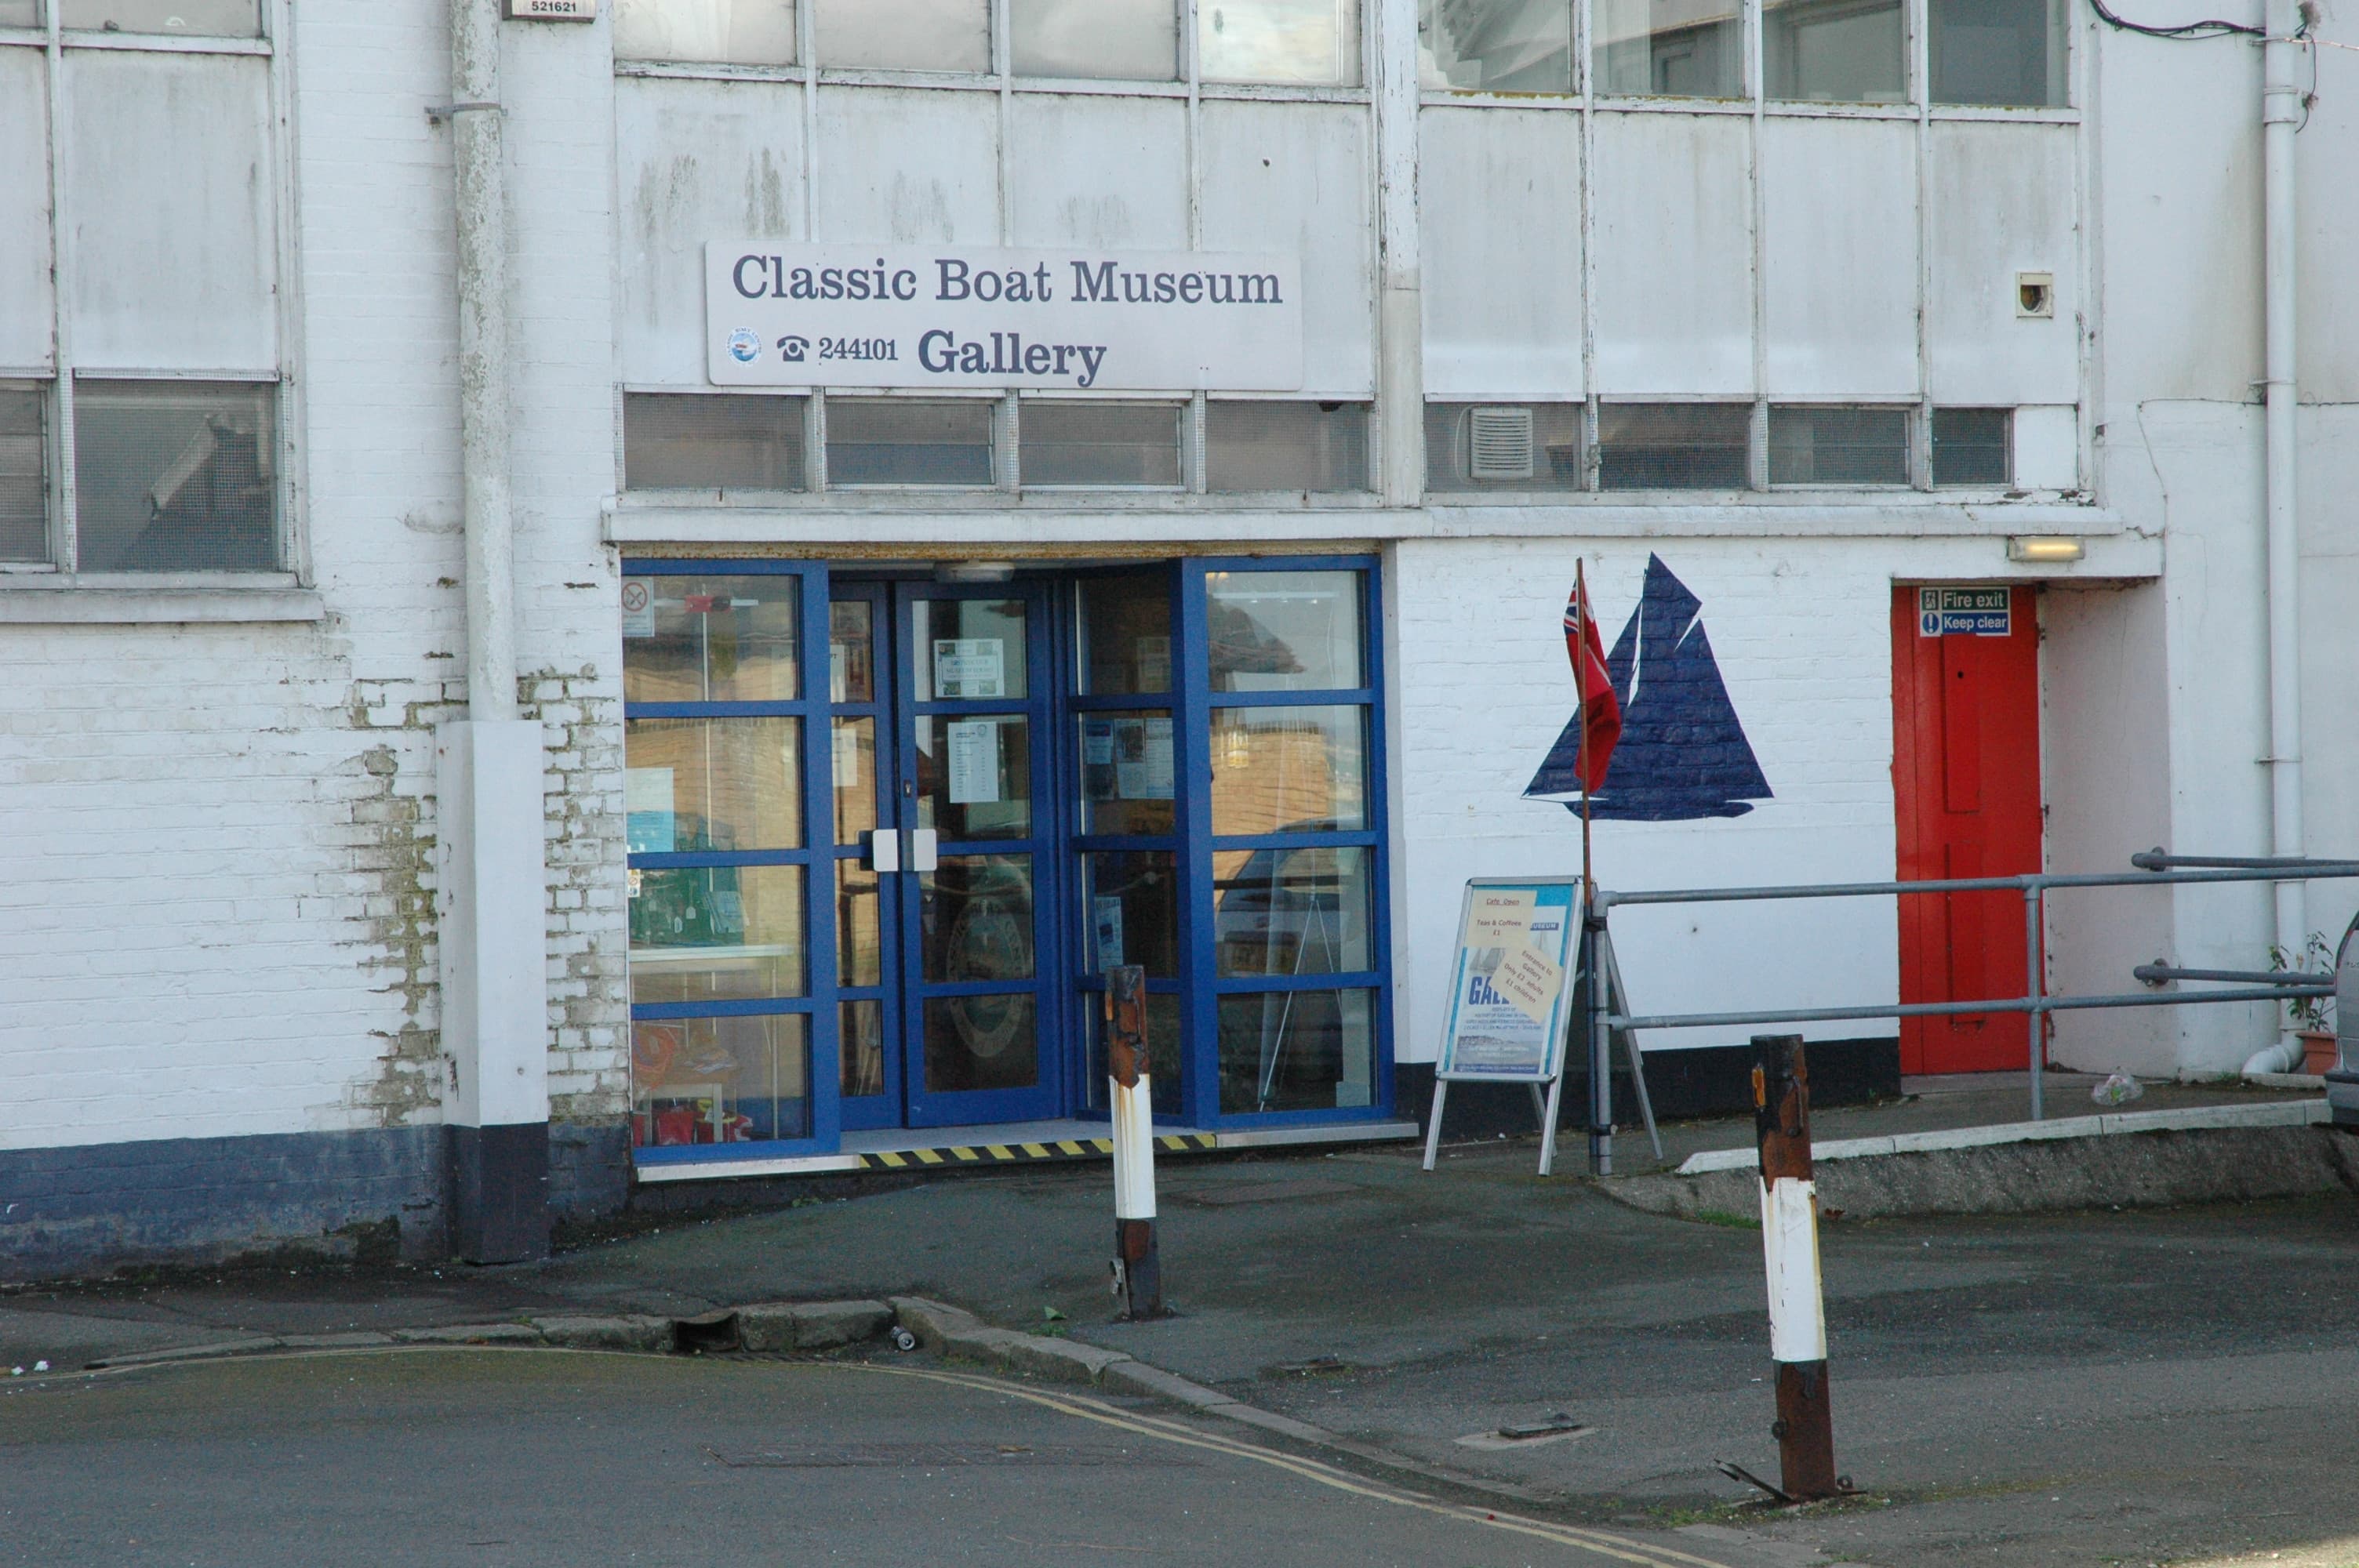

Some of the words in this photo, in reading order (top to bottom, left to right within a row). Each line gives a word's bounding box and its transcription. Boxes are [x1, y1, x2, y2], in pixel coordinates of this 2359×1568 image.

[532, 1, 576, 12] 521621
[732, 255, 917, 301] Classic
[934, 258, 1052, 301] Boat
[1070, 260, 1283, 304] Museum
[818, 337, 899, 361] 244101
[918, 328, 1107, 387] Gallery
[1943, 592, 1972, 608] Fire
[1976, 592, 2004, 608] exit
[1944, 616, 1974, 631] Keep
[1977, 616, 2006, 628] clear
[1504, 963, 1517, 975] Only
[1521, 949, 1546, 971] Entrance
[1546, 967, 1553, 976] to
[1522, 963, 1542, 980] Gallery
[1514, 985, 1536, 1004] children
